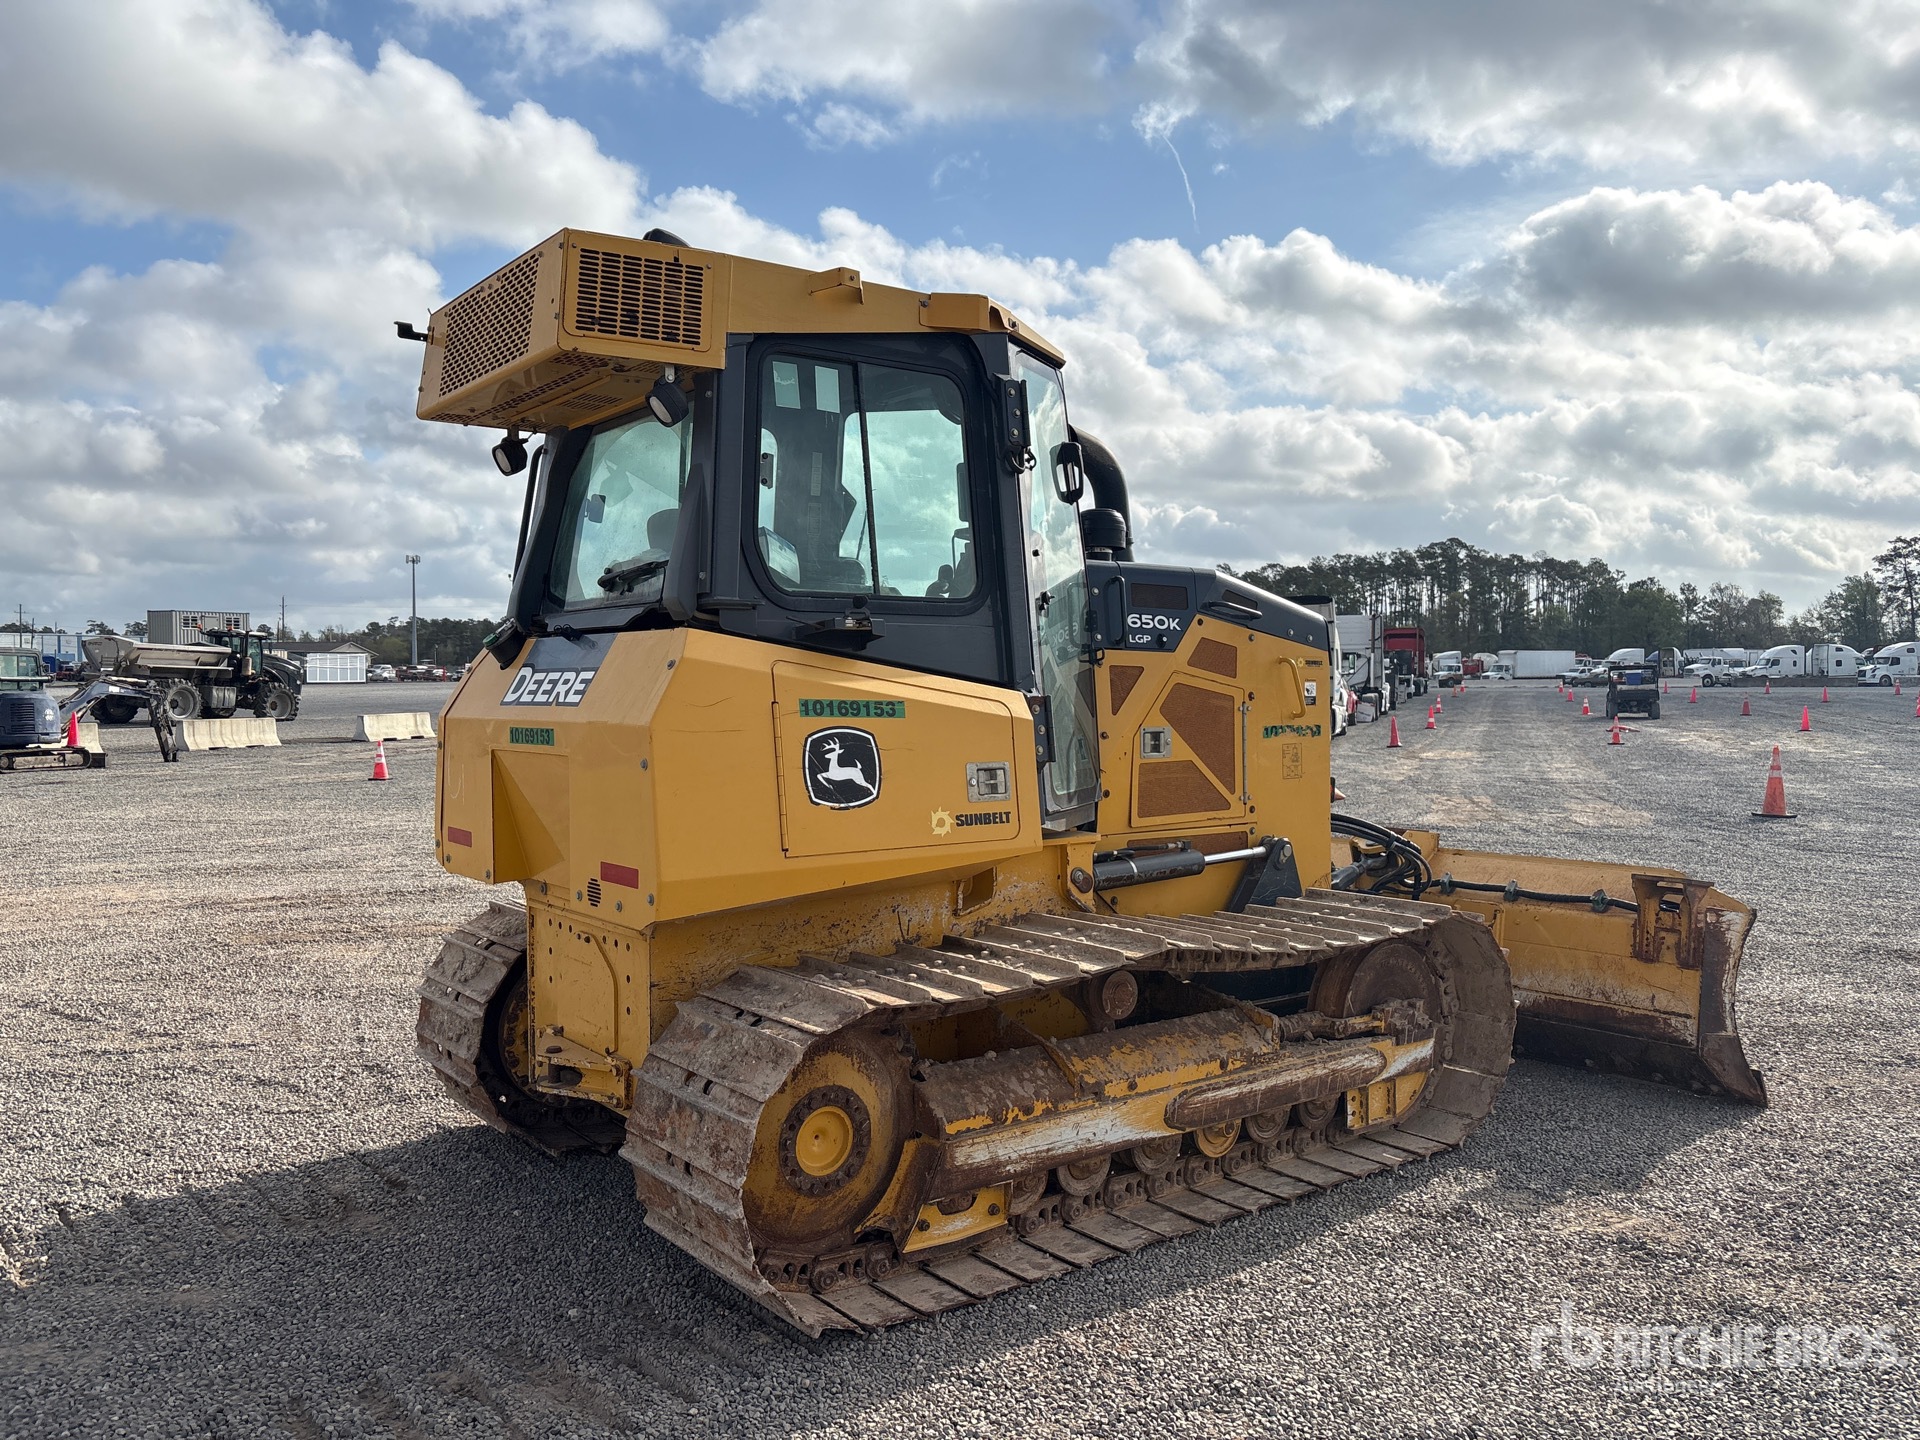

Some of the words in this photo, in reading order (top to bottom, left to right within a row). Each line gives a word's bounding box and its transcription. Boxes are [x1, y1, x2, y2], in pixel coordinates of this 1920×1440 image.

[1127, 613, 1181, 631] 650K
[1129, 634, 1151, 643] LGP
[502, 667, 596, 703] DEERE
[801, 700, 897, 717] 10169153
[510, 728, 550, 745] 10169153
[955, 811, 1011, 827] SUNBELT
